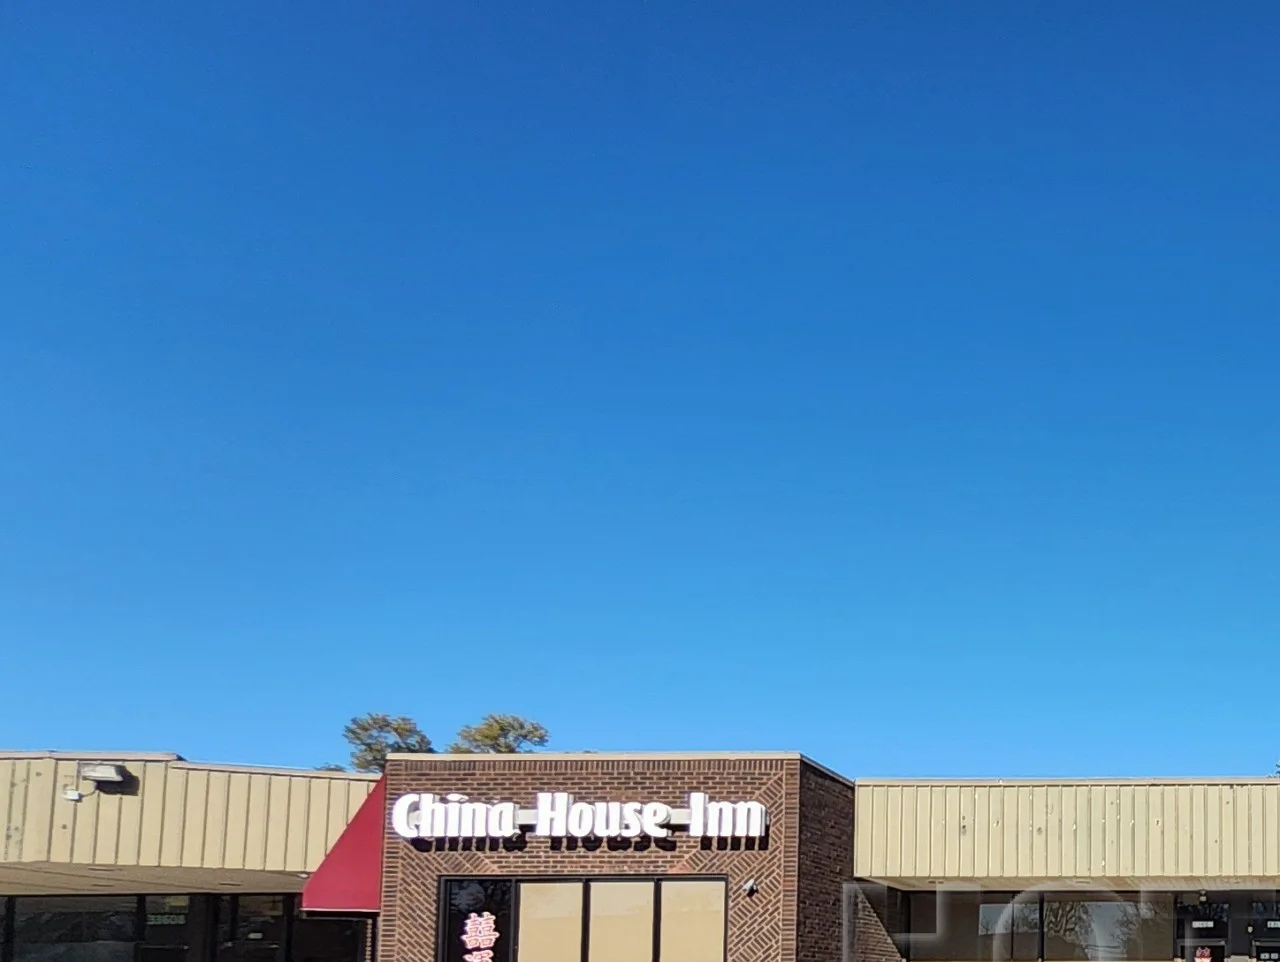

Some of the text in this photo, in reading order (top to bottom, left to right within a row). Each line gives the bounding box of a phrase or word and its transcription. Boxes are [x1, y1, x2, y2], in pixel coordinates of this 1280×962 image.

[393, 792, 767, 837] China House Inn
